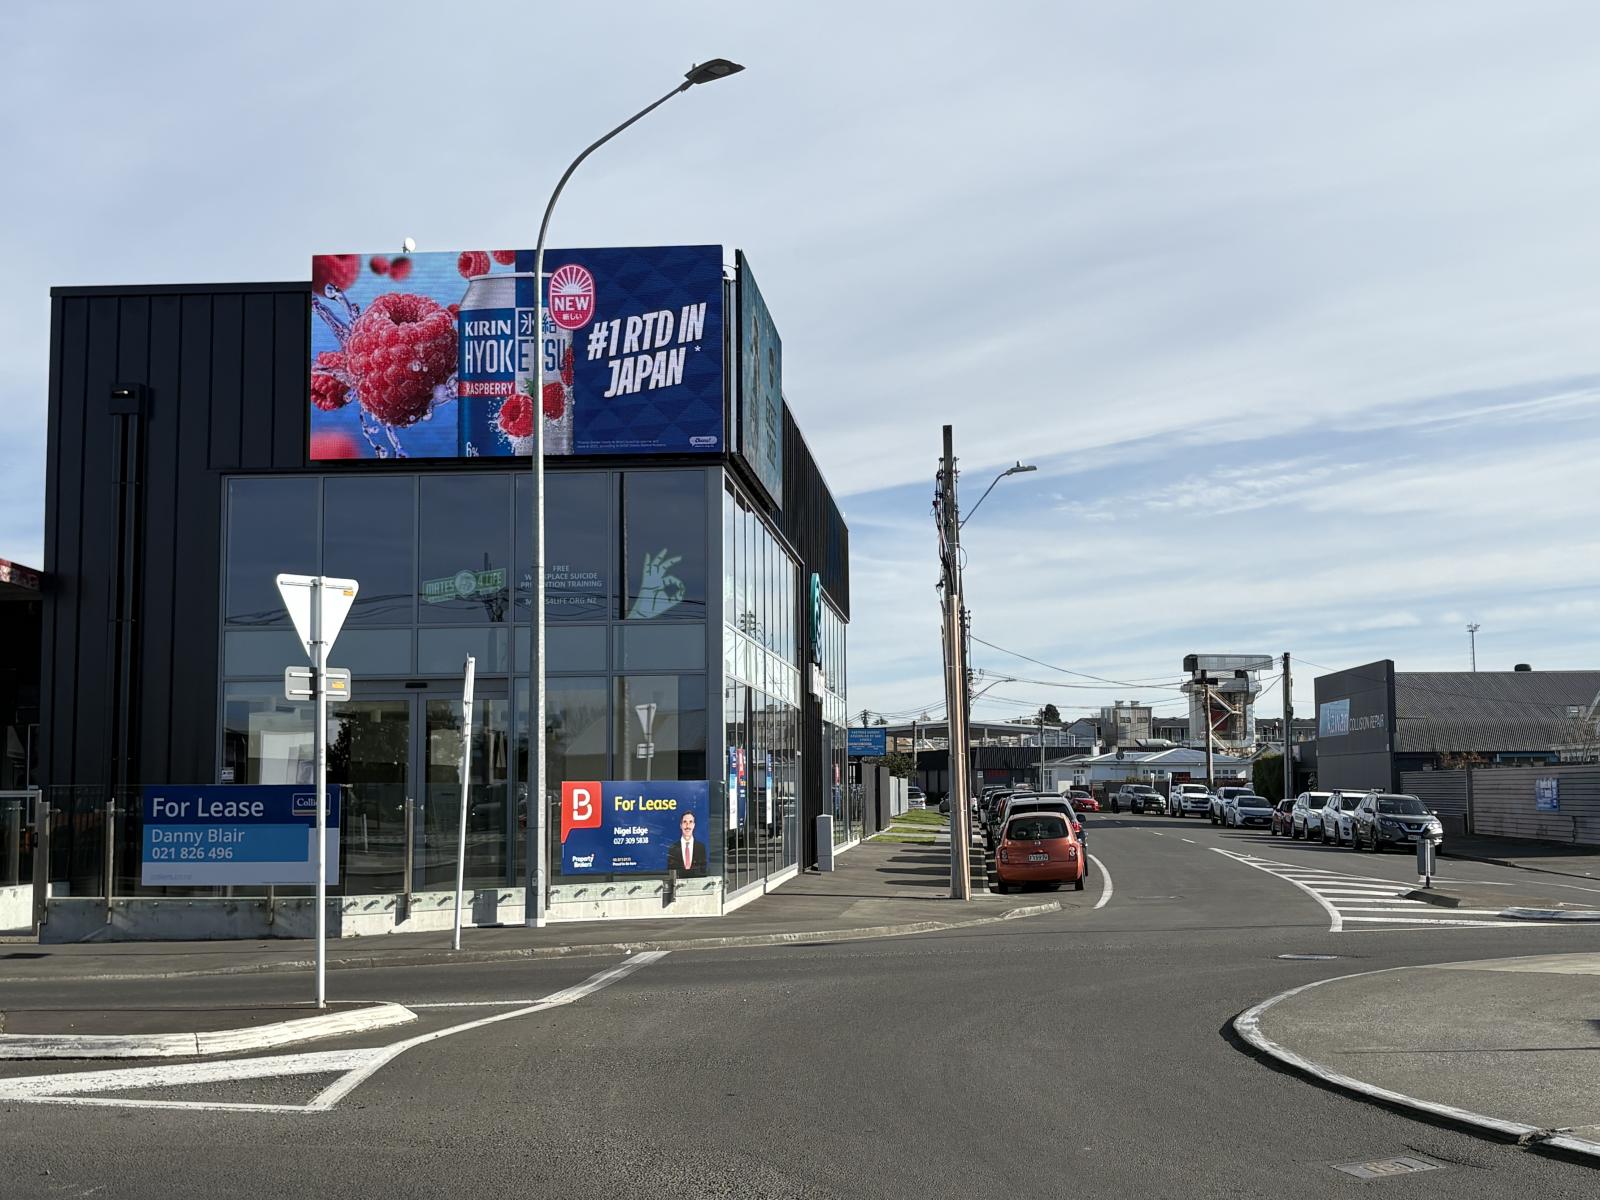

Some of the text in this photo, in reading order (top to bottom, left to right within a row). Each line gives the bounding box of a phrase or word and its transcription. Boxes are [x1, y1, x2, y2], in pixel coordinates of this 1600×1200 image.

[554, 296, 590, 311] NEW
[465, 319, 512, 337] KIRIN
[587, 302, 707, 361] #1 RTD IN
[465, 339, 566, 374] HYOKESU
[603, 346, 687, 398] JAPAN
[466, 381, 514, 396] RASPBERRY
[426, 580, 455, 596] MATES
[486, 571, 502, 585] LIFE
[568, 579, 602, 587] TRAINING
[569, 572, 598, 580] SUICIDE
[152, 797, 265, 818] For Lease
[614, 795, 677, 812] For Lease
[152, 828, 246, 847] Danny Blair
[613, 826, 649, 837] Nigel Edge
[613, 837, 624, 845] 027
[152, 847, 234, 859] 021 826 496
